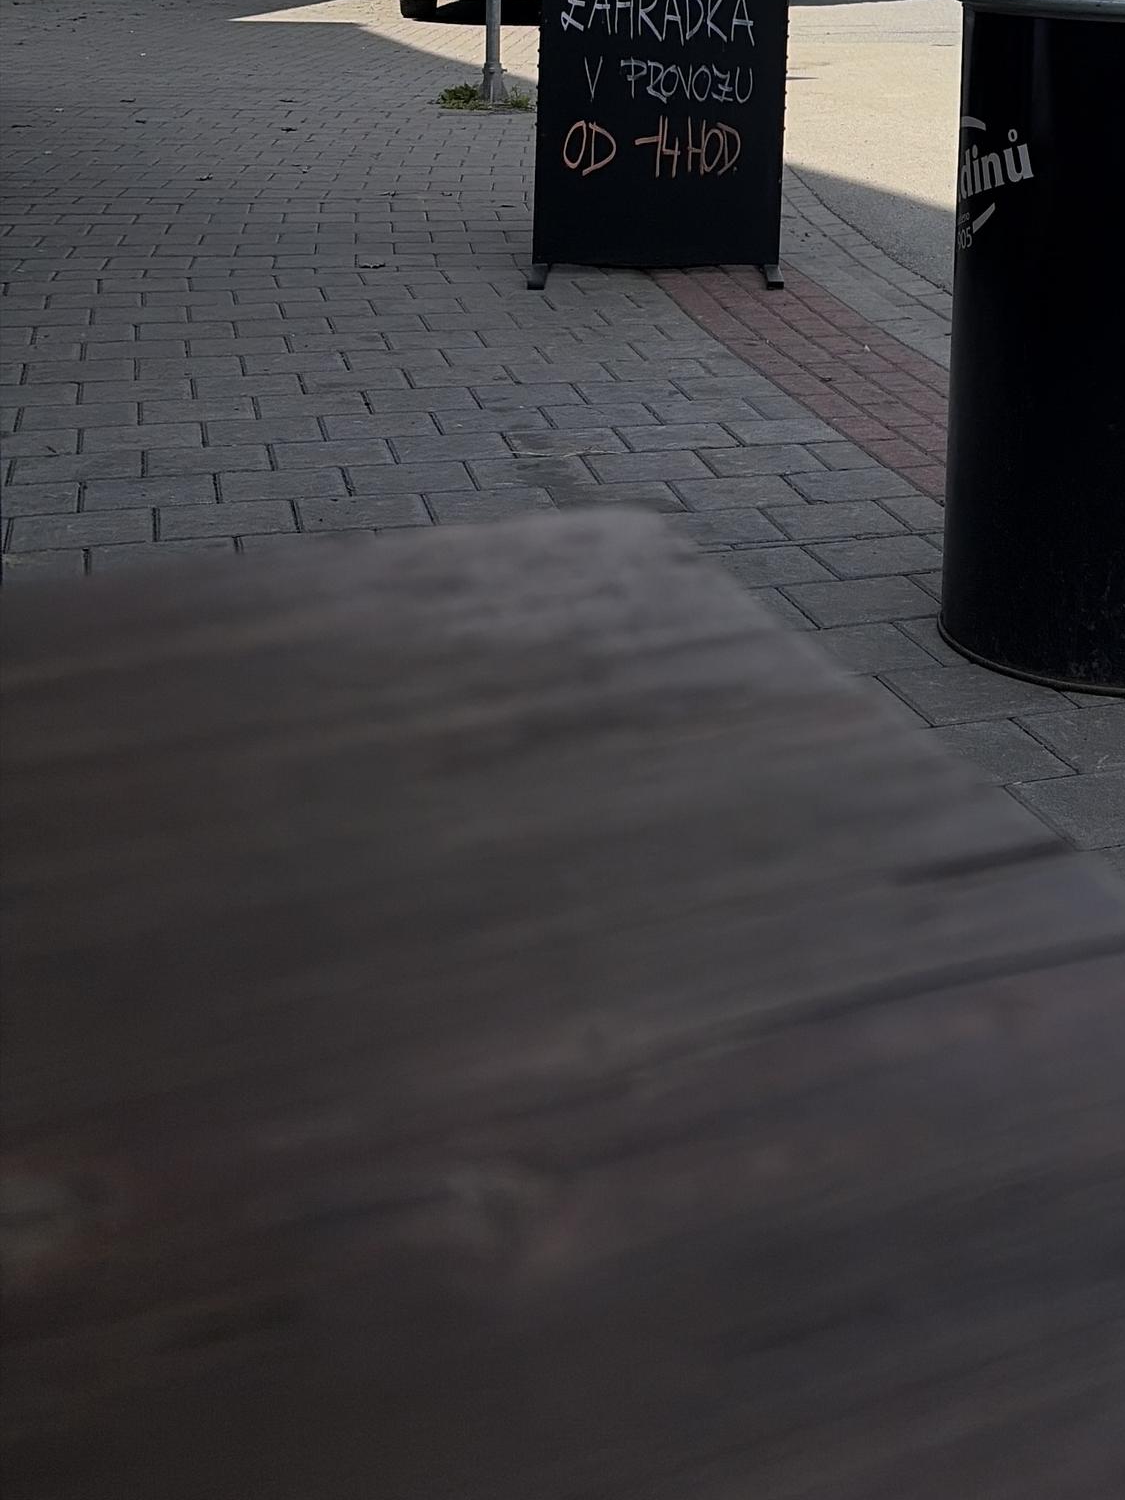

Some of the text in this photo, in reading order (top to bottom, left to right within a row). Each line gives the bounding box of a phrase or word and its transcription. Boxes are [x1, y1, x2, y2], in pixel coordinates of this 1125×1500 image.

[584, 56, 753, 104] V PROVOZU
[563, 119, 616, 176] OD
